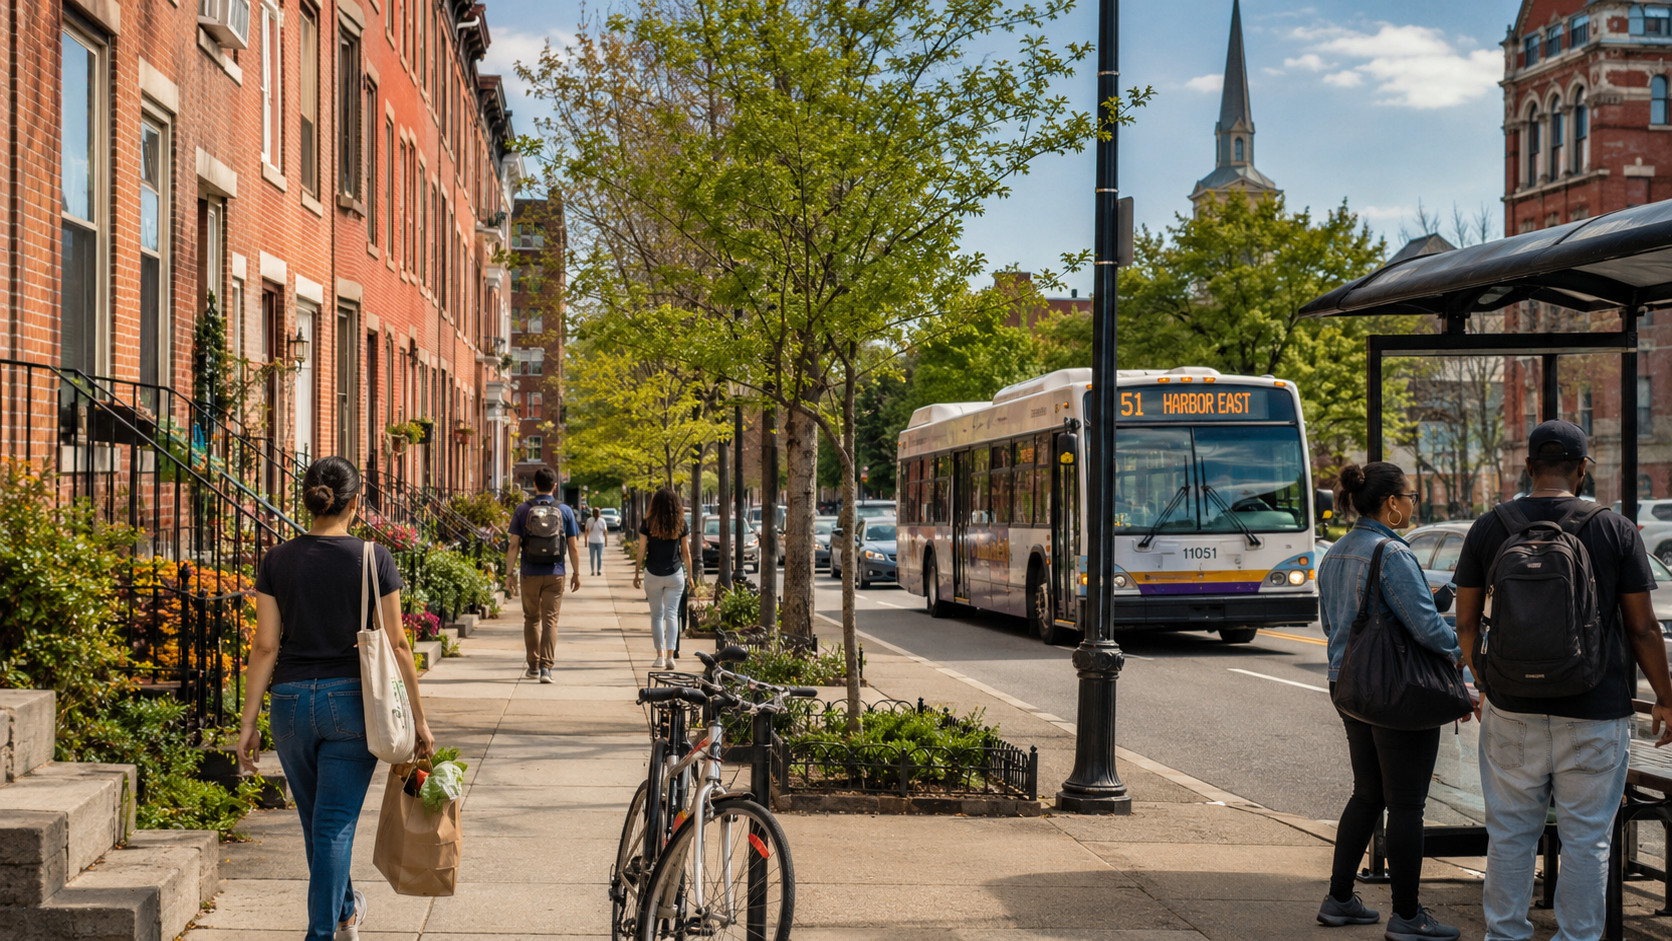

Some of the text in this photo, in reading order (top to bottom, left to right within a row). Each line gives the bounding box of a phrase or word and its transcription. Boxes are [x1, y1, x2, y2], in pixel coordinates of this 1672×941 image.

[1121, 392, 1251, 416] 51 HARBOR EAST
[1183, 547, 1217, 559] 11051
